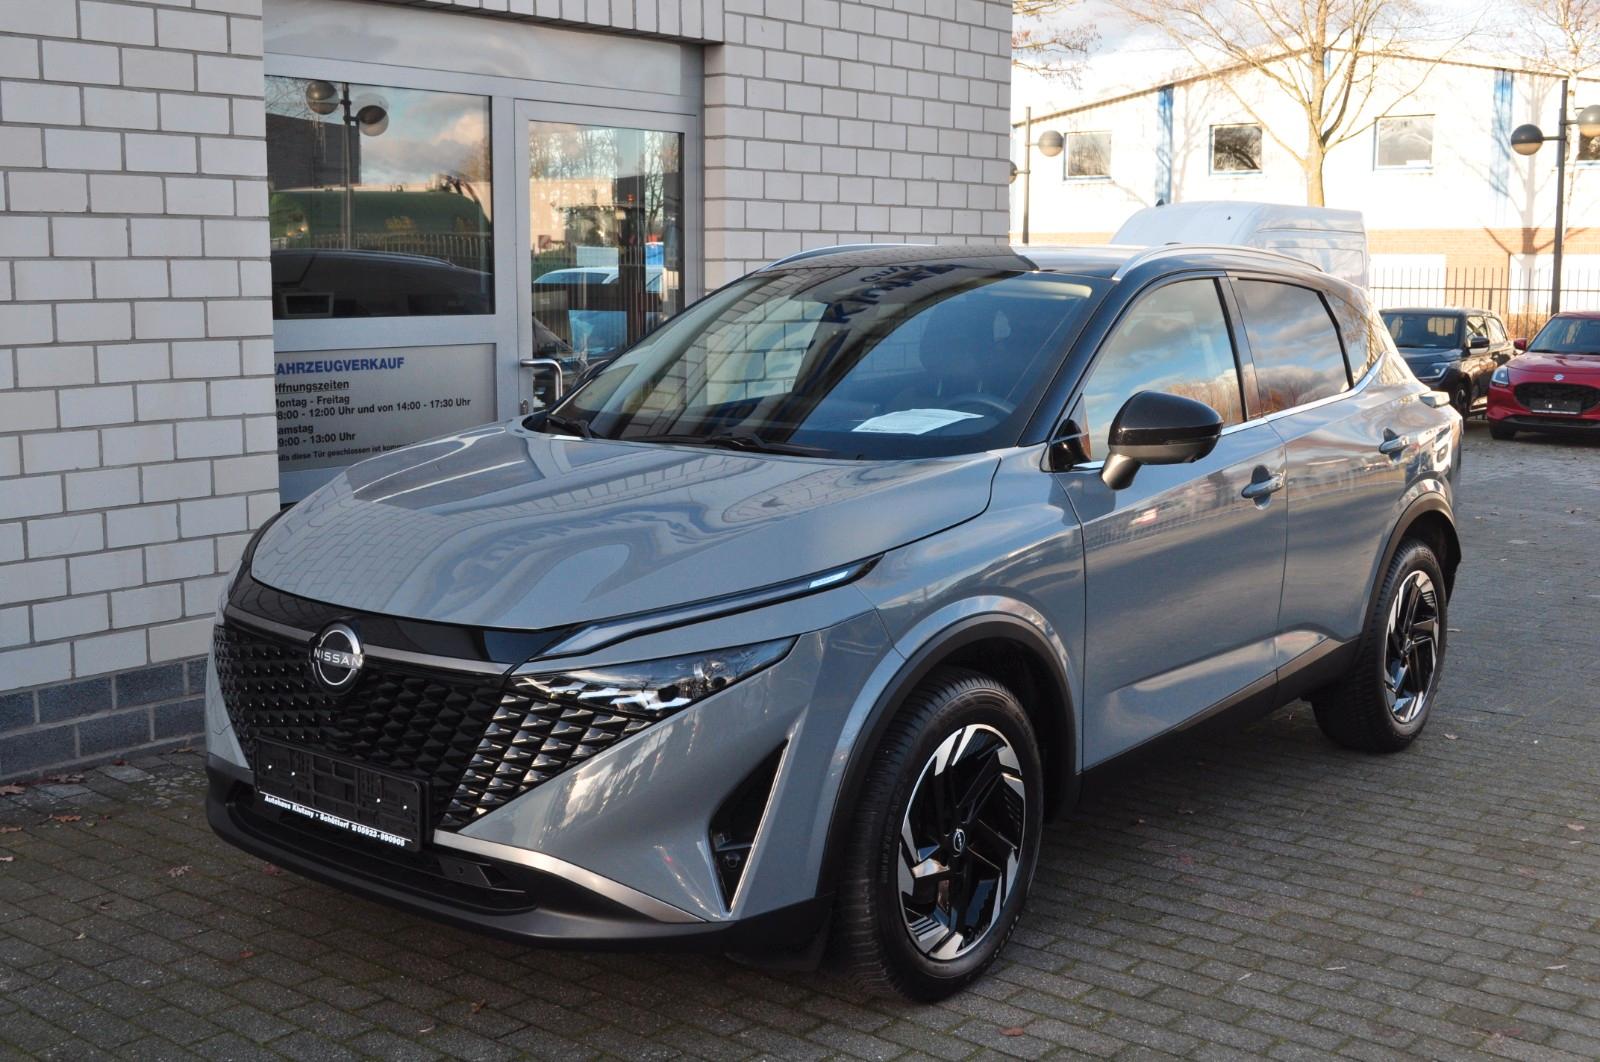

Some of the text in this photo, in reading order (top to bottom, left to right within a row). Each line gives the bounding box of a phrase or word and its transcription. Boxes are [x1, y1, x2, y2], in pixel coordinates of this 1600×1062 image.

[275, 357, 405, 375] AHRZEUGVERKAUF
[309, 407, 336, 417] 12:00
[338, 406, 355, 415] Uhr
[357, 404, 375, 414] und
[377, 403, 393, 412] von
[396, 401, 421, 411] 14:00
[430, 399, 453, 408] 17:30
[455, 398, 472, 407] Uhr
[316, 395, 350, 405] Freitag
[277, 424, 314, 435] amstag
[310, 433, 336, 444] 13:00
[339, 431, 356, 441] Uhr
[313, 647, 364, 667] NISSAN
[264, 795, 292, 810] Autohaus
